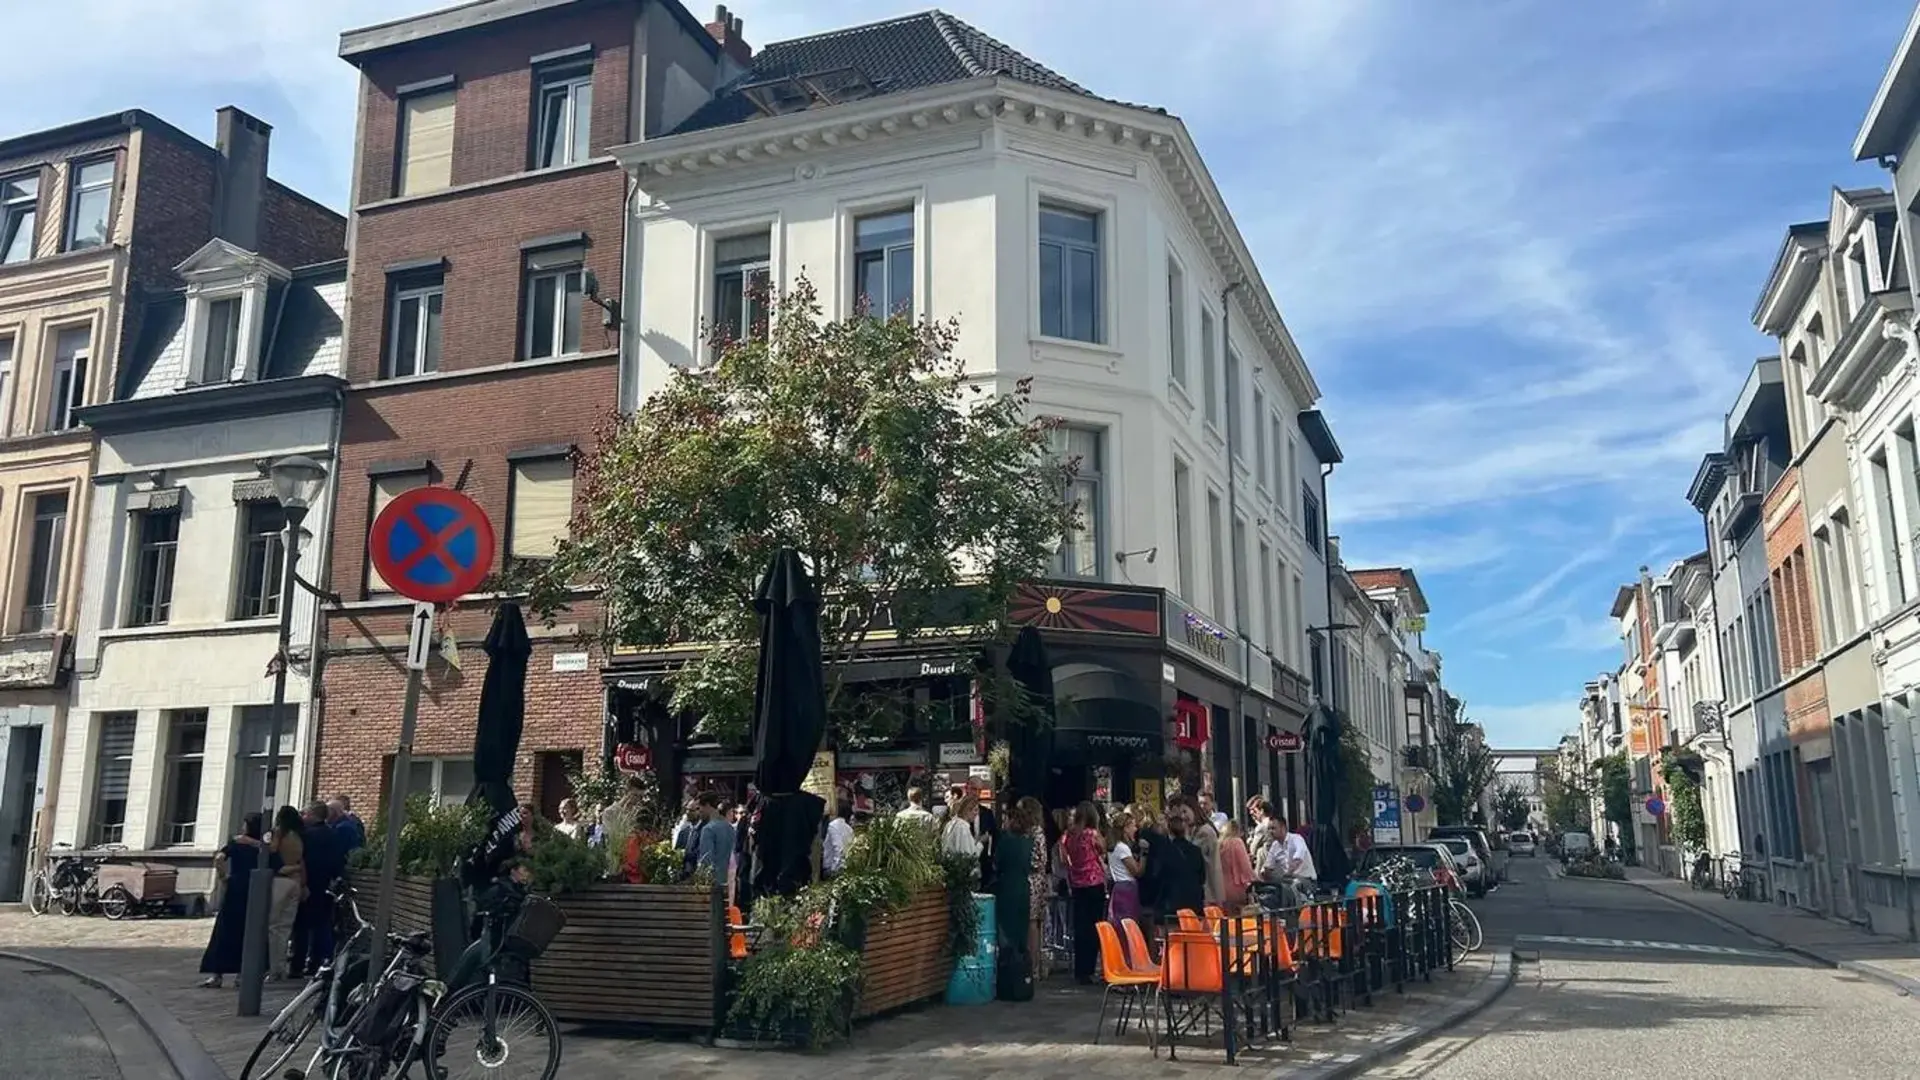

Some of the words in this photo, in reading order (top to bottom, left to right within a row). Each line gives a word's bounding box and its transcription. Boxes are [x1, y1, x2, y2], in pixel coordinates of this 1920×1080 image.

[920, 661, 956, 676] Duvel
[1270, 736, 1297, 748] Cristal
[1374, 800, 1387, 818] P
